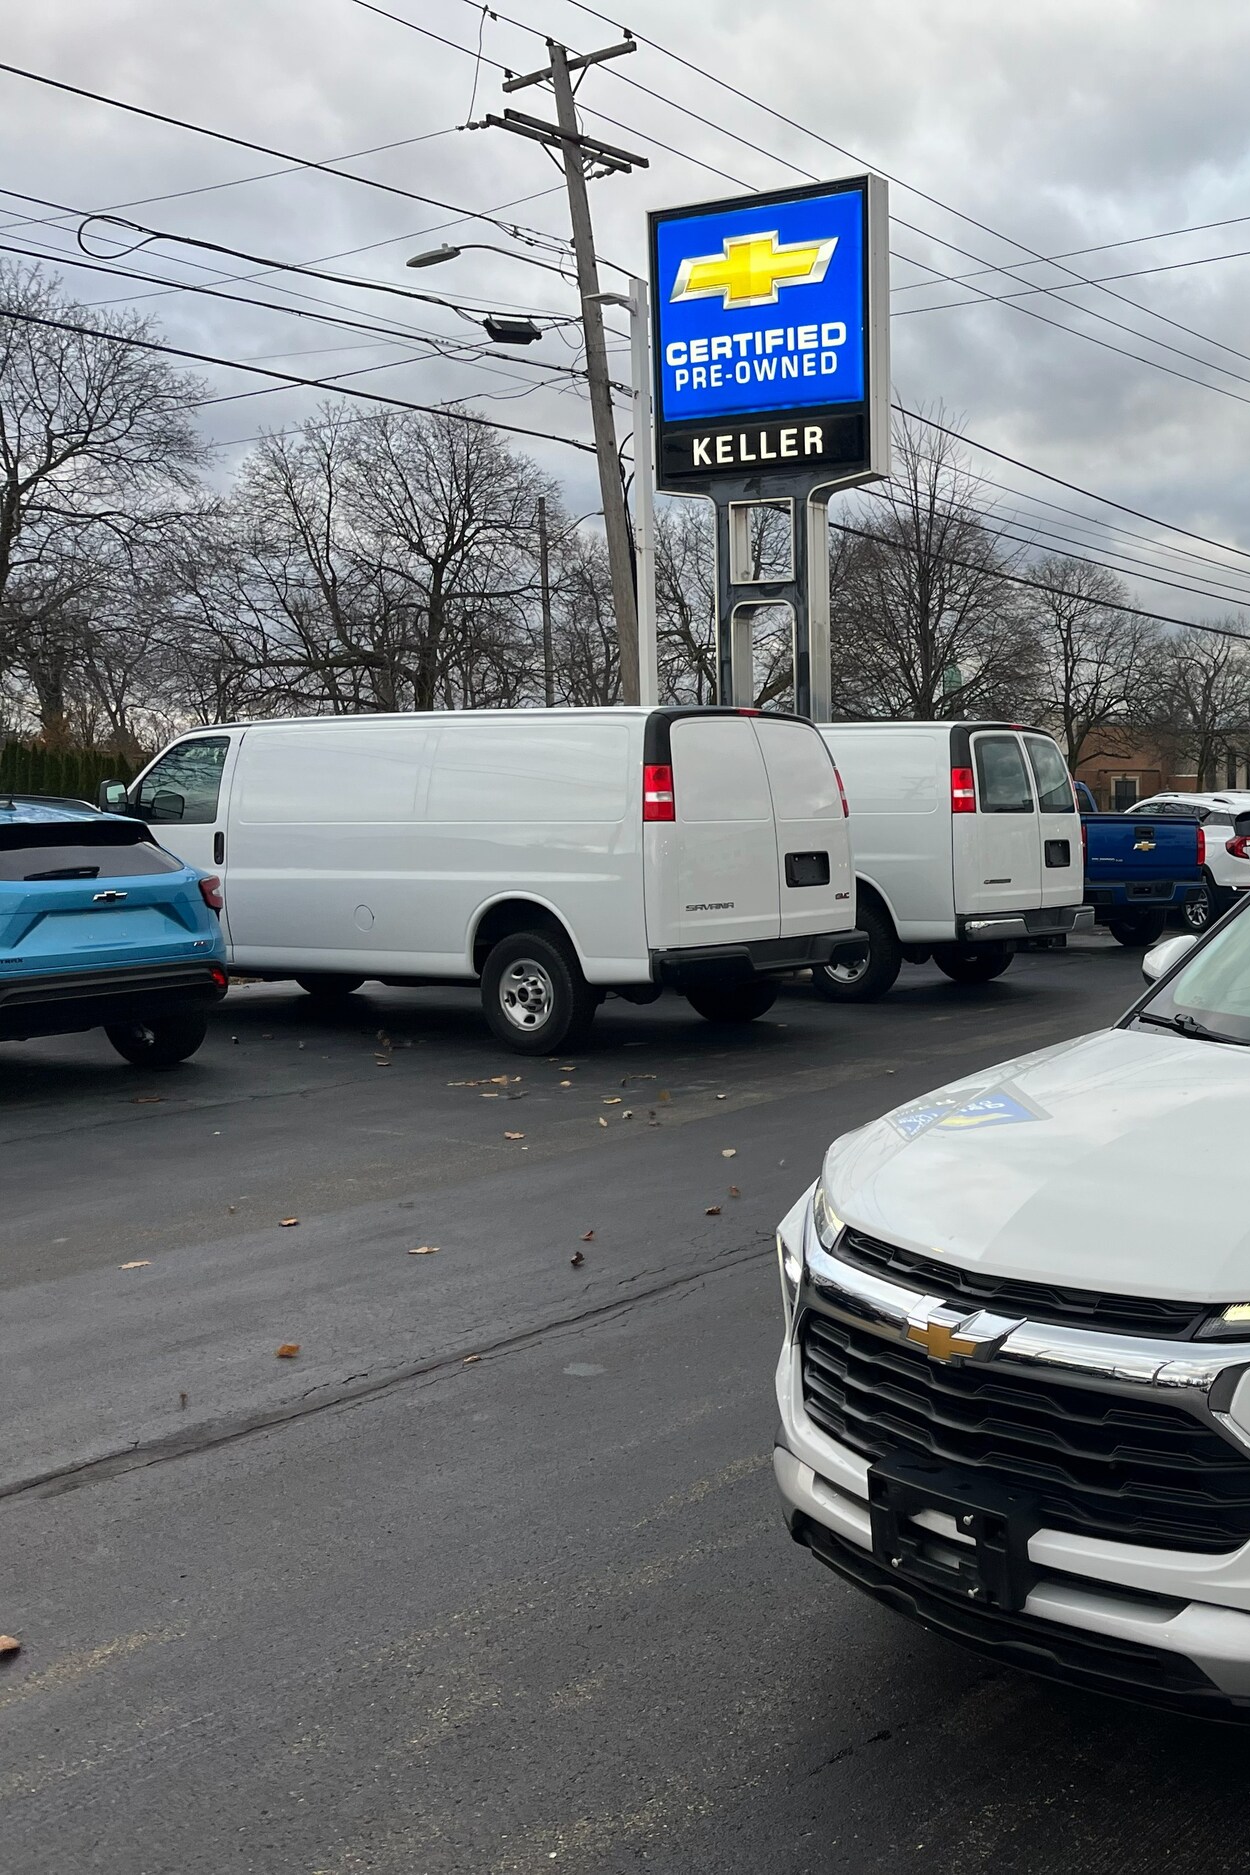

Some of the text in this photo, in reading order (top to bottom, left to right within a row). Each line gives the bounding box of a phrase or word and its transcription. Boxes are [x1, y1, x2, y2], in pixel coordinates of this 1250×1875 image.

[665, 321, 847, 367] CERTIFIED
[675, 351, 838, 392] PRE-OWNED
[692, 425, 824, 467] KELLER
[685, 901, 735, 912] SAVANA
[835, 892, 850, 900] GMC
